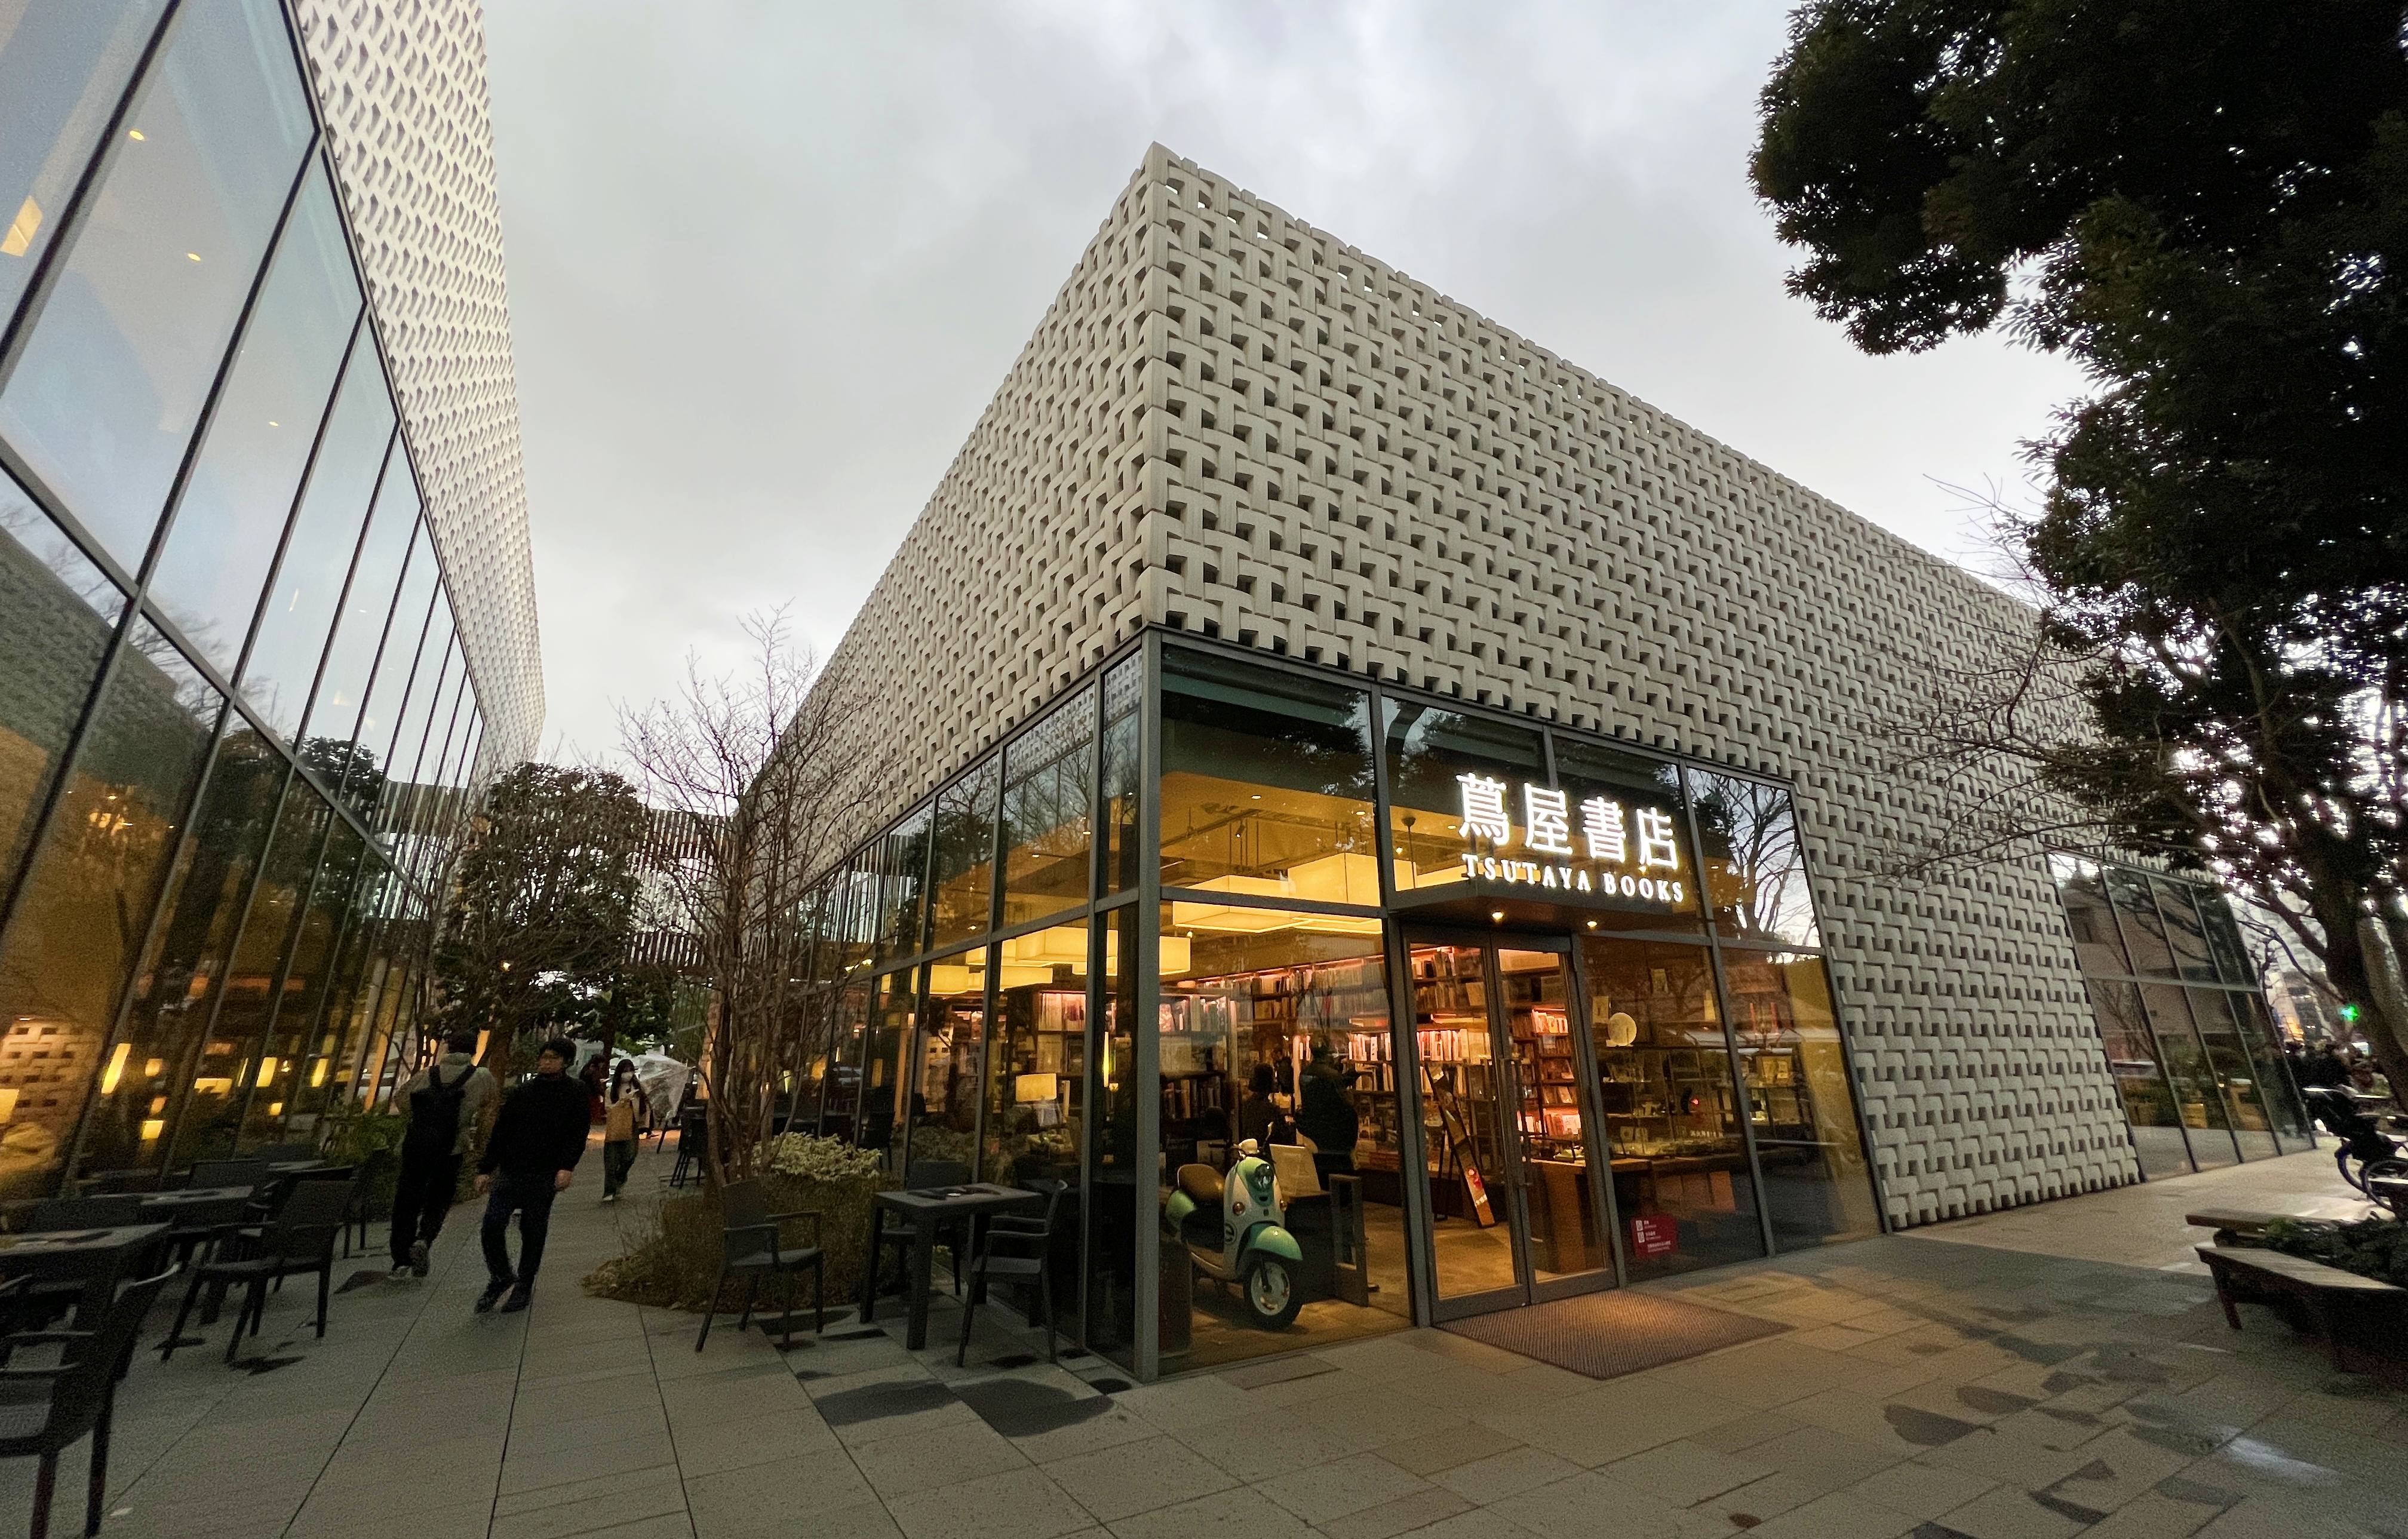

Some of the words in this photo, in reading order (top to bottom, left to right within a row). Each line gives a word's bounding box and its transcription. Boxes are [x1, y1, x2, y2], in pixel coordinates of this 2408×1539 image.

[1456, 772, 1679, 870] 蔦屋書店
[1461, 853, 1592, 892] TSUTAYA
[1602, 872, 1684, 902] BOOKS
